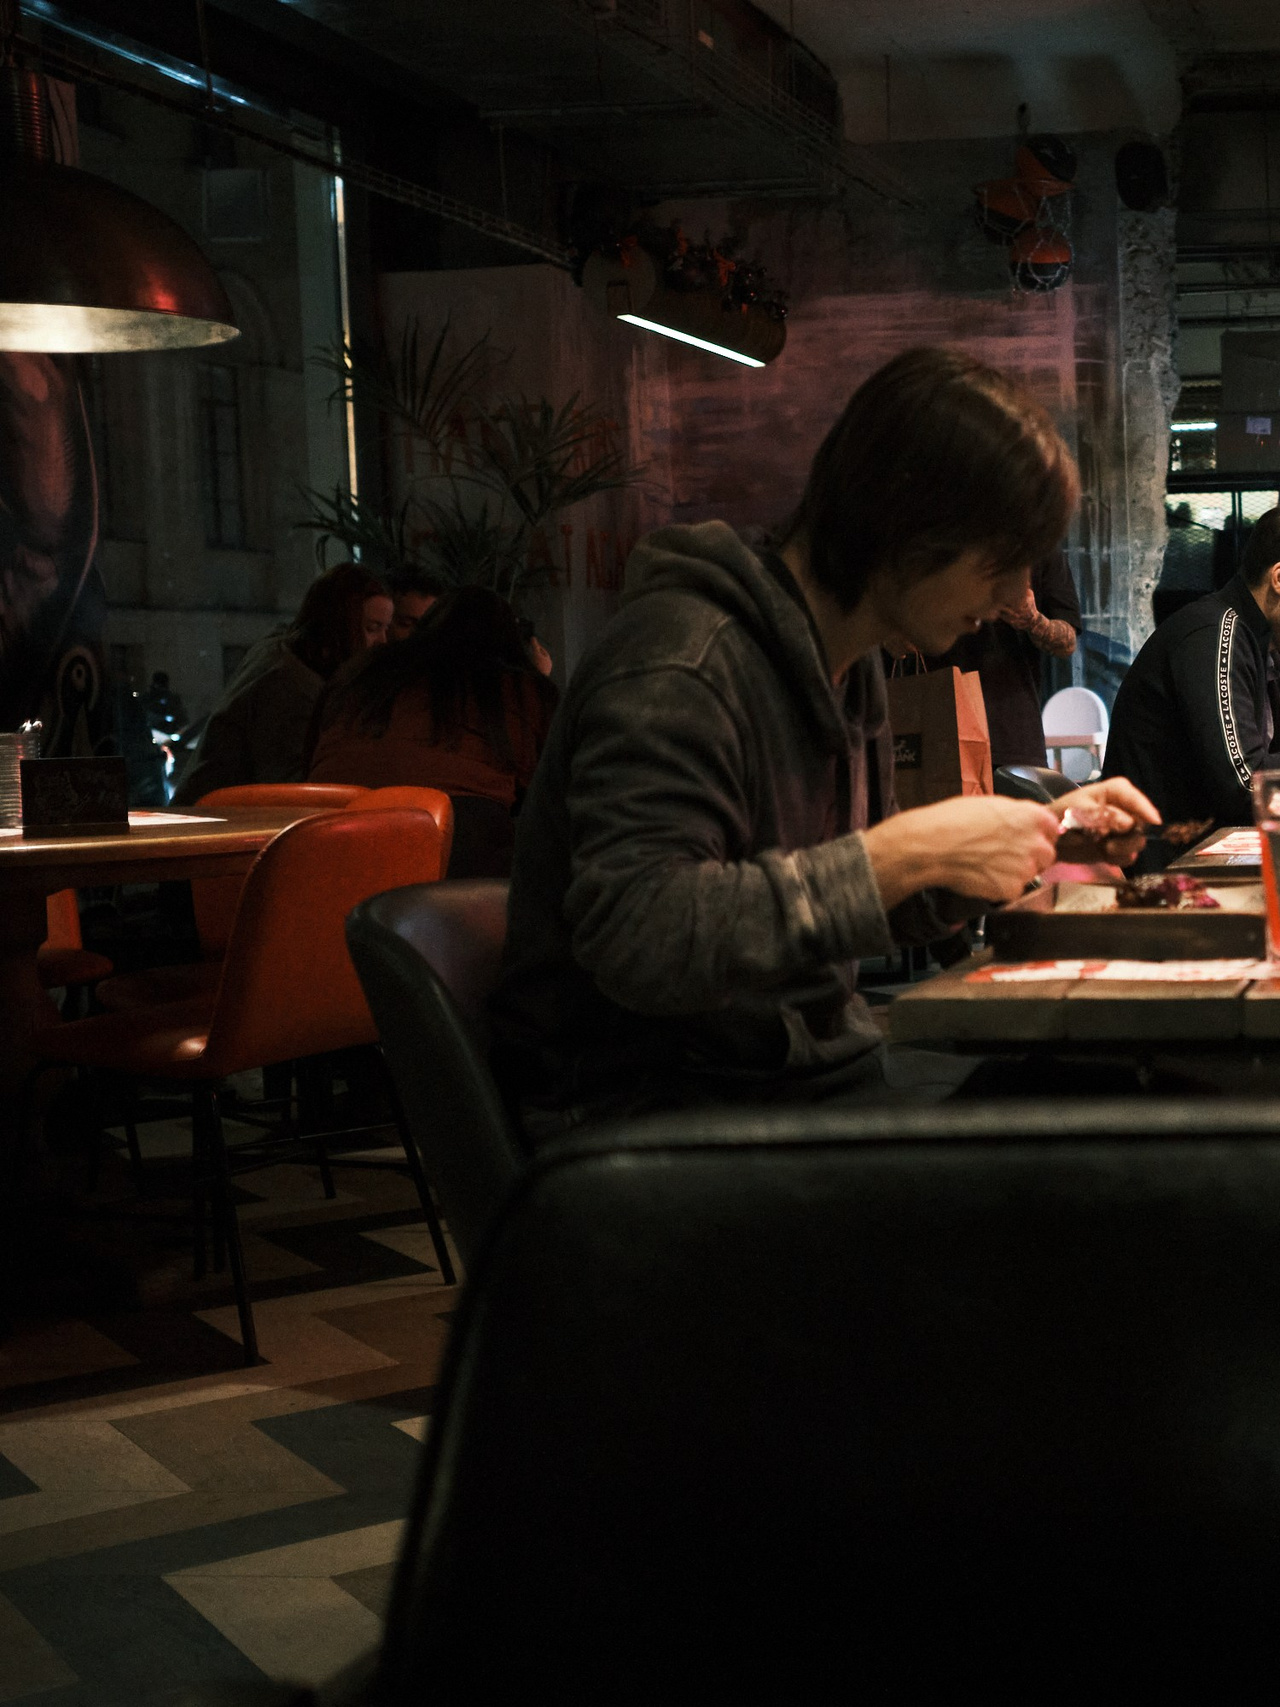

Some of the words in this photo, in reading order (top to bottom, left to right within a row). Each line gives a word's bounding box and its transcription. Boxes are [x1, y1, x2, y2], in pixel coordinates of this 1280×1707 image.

[1222, 616, 1233, 655] LACOSTE
[1220, 666, 1229, 712] LACOSTE
[1225, 723, 1243, 767] LACOSTE
